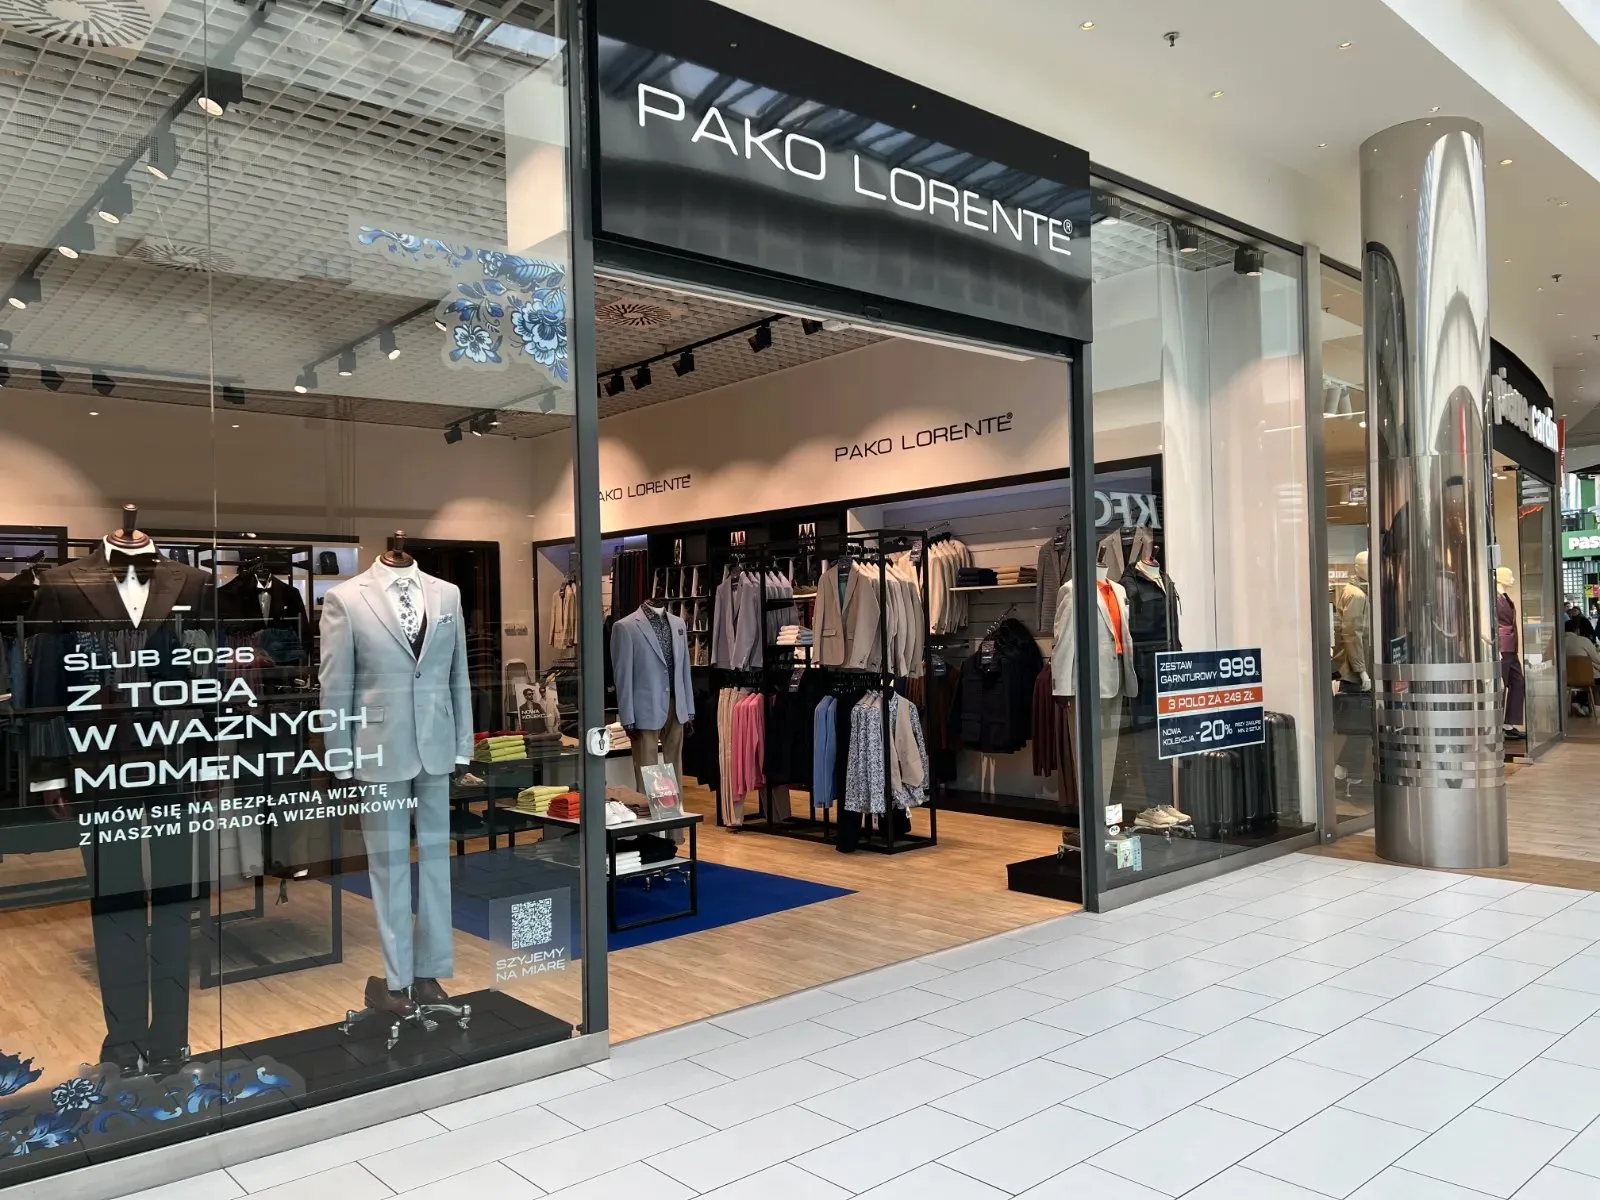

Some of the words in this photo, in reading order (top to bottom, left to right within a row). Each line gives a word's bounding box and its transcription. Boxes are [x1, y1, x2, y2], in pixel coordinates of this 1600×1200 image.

[637, 82, 826, 181] PAKO
[834, 438, 893, 462] PAKO
[598, 487, 623, 502] AKO
[1568, 535, 1600, 551] pas
[63, 644, 161, 671] ŚLUB
[171, 646, 255, 666] 2026
[1160, 661, 1193, 672] ZESTAW
[1219, 656, 1256, 679] 999
[1160, 671, 1218, 684] GARNITUROWY
[66, 684, 102, 712] Z
[118, 677, 258, 708] TOBĄ
[1168, 699, 1176, 710] 3
[1178, 696, 1206, 708] POLO
[1208, 695, 1221, 706] ZA
[68, 724, 118, 753] W
[133, 706, 367, 748] WAŻNYCH
[1162, 727, 1182, 736] NOWA
[1162, 735, 1195, 746] KOLEKCJA
[74, 744, 384, 794] MOMENTACH
[78, 806, 144, 826] UMÓW
[150, 804, 182, 820] SIĘ
[188, 801, 214, 815] NA
[220, 790, 323, 811] BEZPŁATNĄ
[327, 783, 388, 800] WIZYTĘ
[79, 832, 92, 846] Z
[98, 822, 181, 844] NASZYM
[188, 812, 279, 834] DORADCĄ
[283, 797, 419, 823] WIZERUNKOWYM
[495, 946, 565, 970] SZYJEMY
[496, 970, 518, 982] NA
[521, 958, 566, 977] MIARĘ
